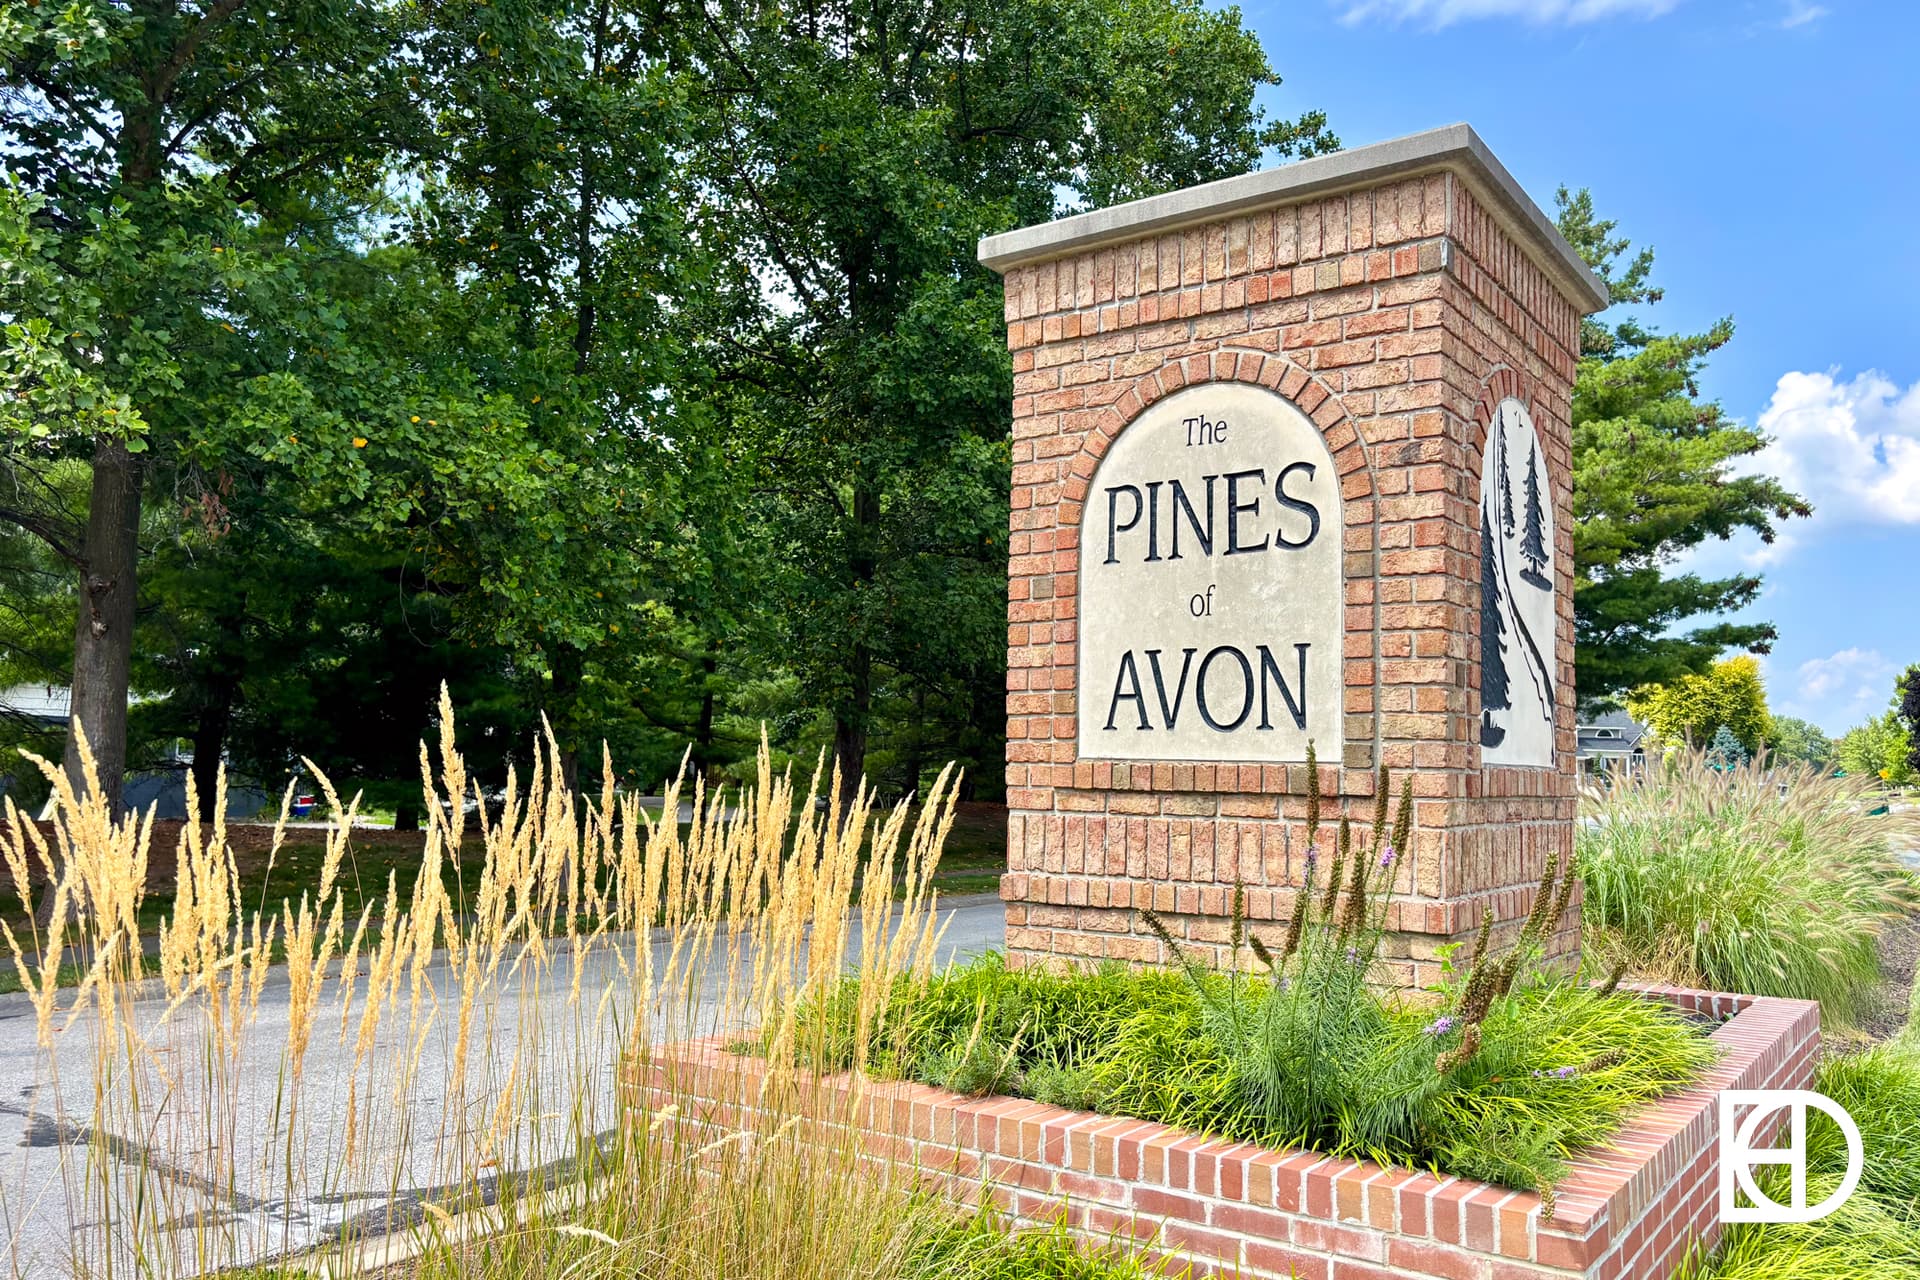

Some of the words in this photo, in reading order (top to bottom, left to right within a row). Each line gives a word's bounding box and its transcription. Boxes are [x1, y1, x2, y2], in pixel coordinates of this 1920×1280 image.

[1182, 414, 1228, 447] The
[1103, 461, 1321, 565] PINES
[1189, 584, 1216, 617] of
[1102, 642, 1312, 733] AVON
